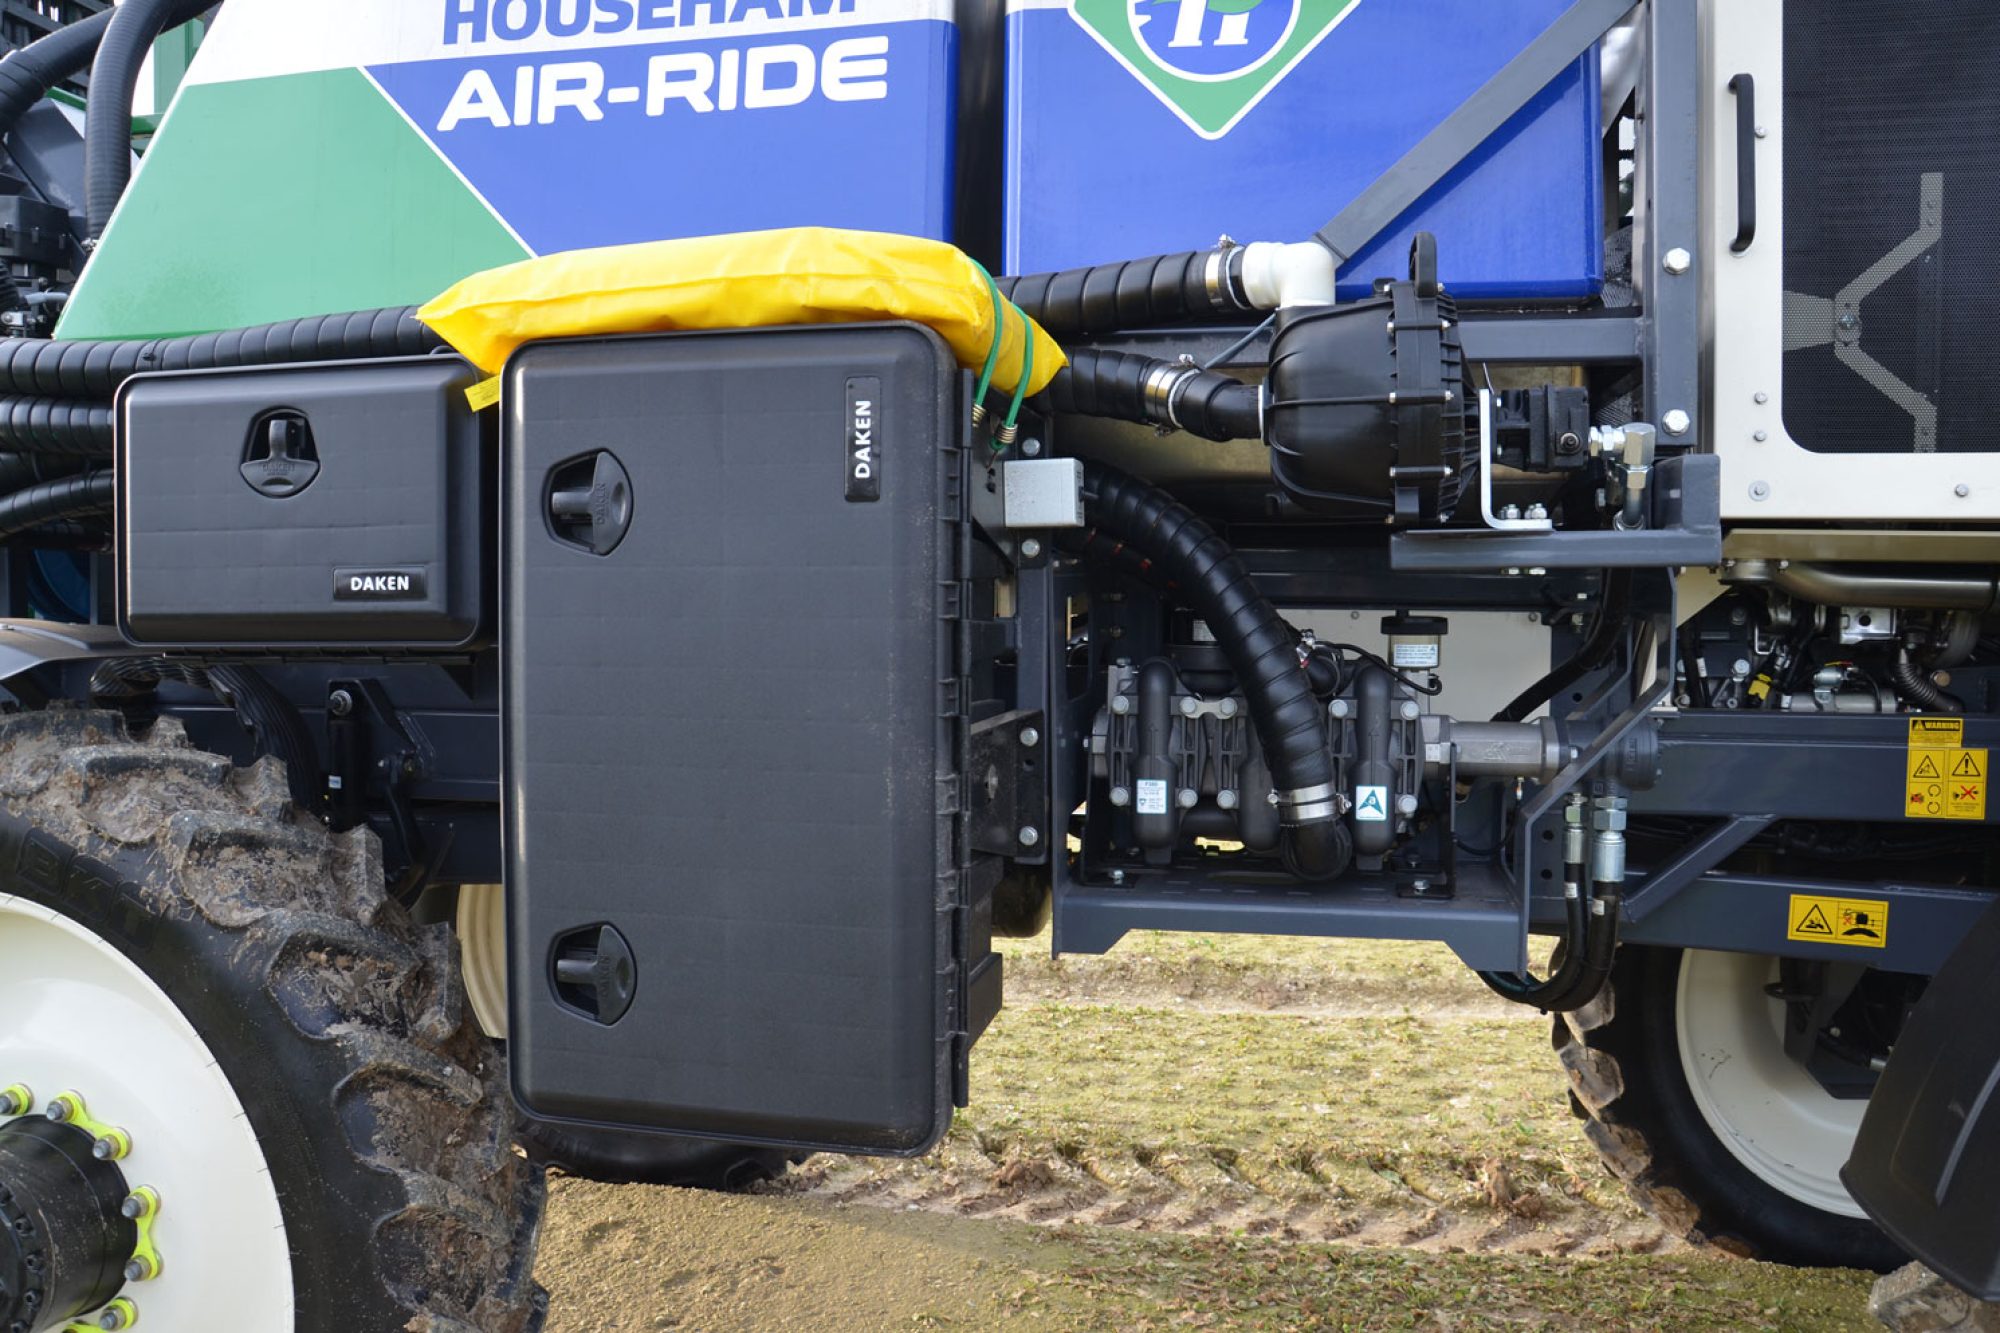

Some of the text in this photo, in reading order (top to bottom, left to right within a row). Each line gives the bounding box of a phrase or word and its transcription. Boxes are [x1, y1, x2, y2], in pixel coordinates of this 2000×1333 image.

[442, 0, 856, 45] HOUSE
[436, 35, 890, 132] AIR-RIDE
[854, 400, 872, 479] DAKEN
[350, 575, 410, 592] DAKEN
